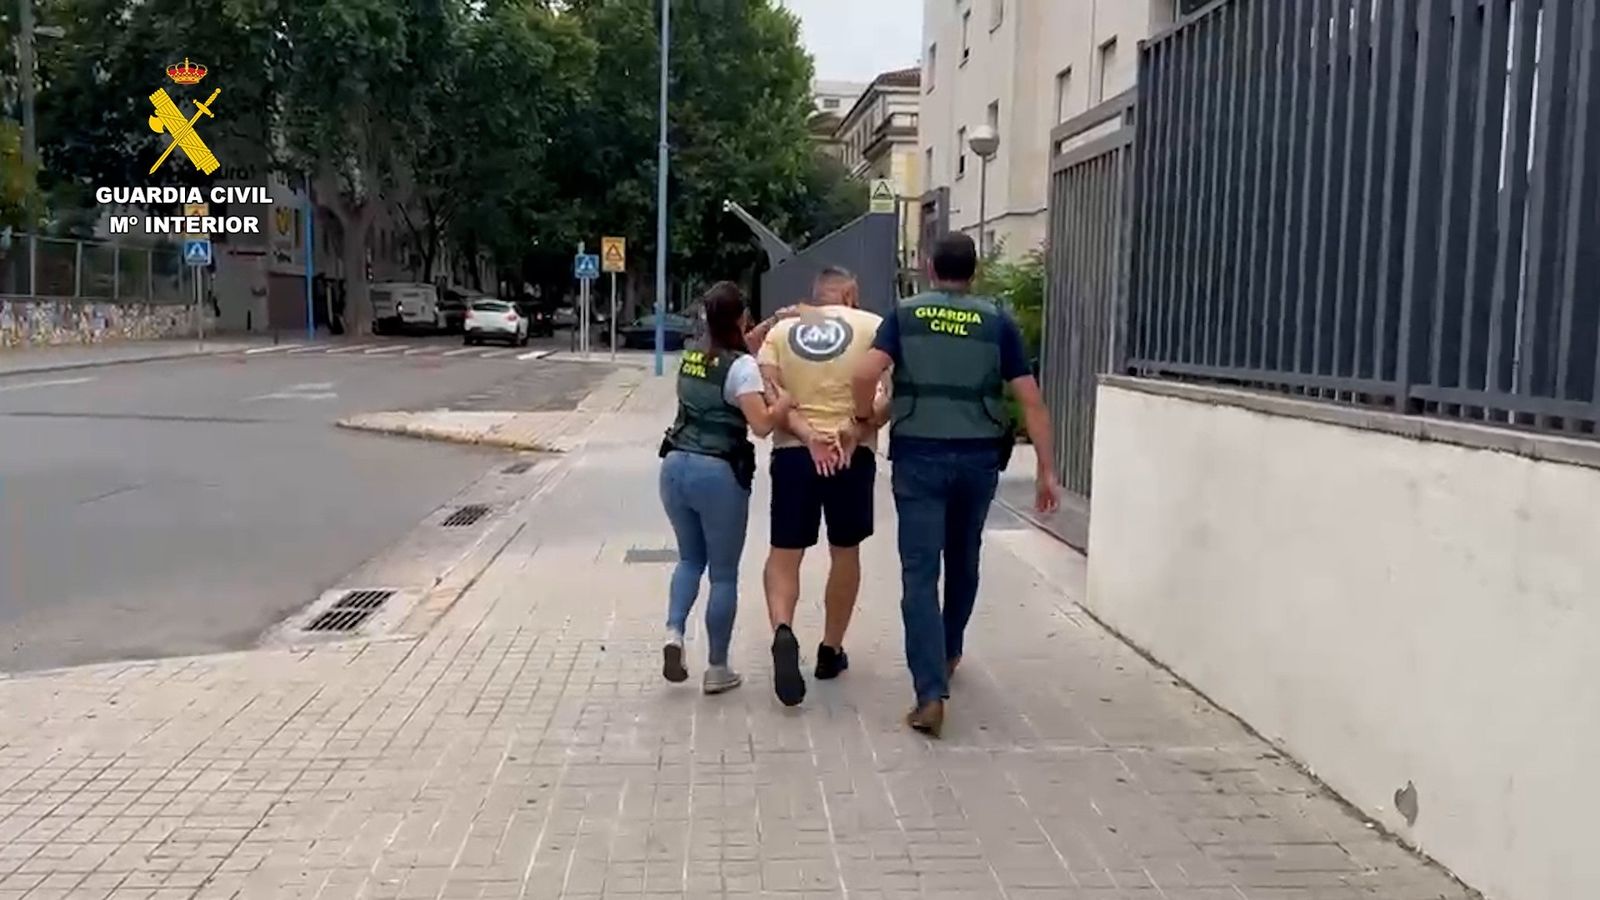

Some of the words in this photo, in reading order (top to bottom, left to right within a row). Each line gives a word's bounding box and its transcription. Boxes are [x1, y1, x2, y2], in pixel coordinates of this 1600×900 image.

[914, 306, 982, 324] GUARDIA
[930, 319, 969, 335] CIVIL
[682, 362, 707, 378] CIVIL
